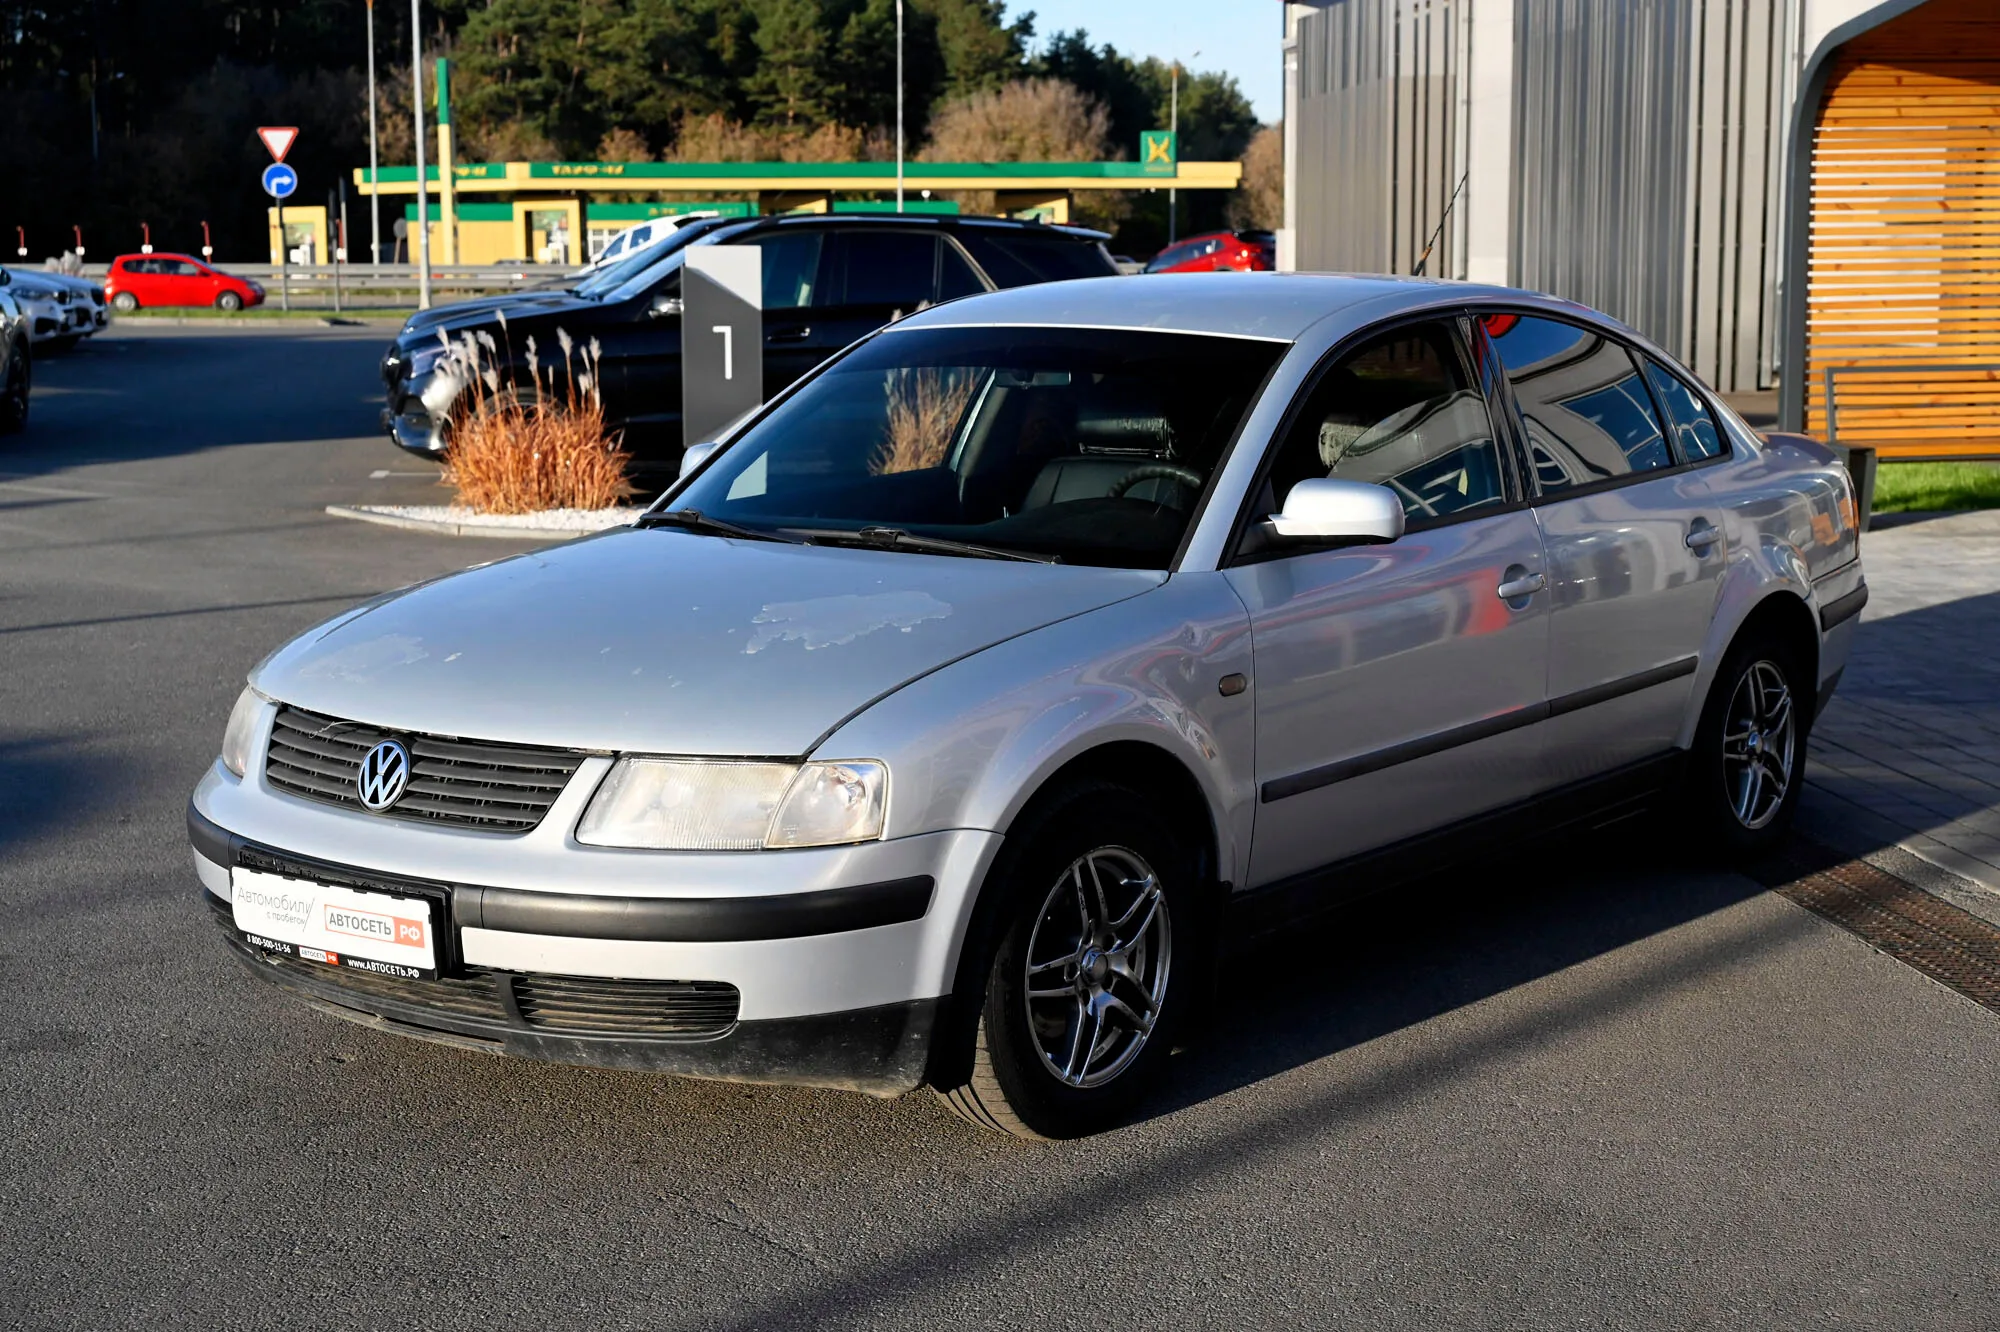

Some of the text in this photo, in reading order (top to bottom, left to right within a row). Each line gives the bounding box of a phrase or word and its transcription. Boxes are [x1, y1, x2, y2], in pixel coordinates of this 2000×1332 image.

[712, 325, 732, 380] 1
[247, 934, 252, 943] 8
[329, 912, 421, 941] АВТОСЕТЬ РФ
[347, 958, 420, 979] www.АВТОСЕТЬ.РФ
